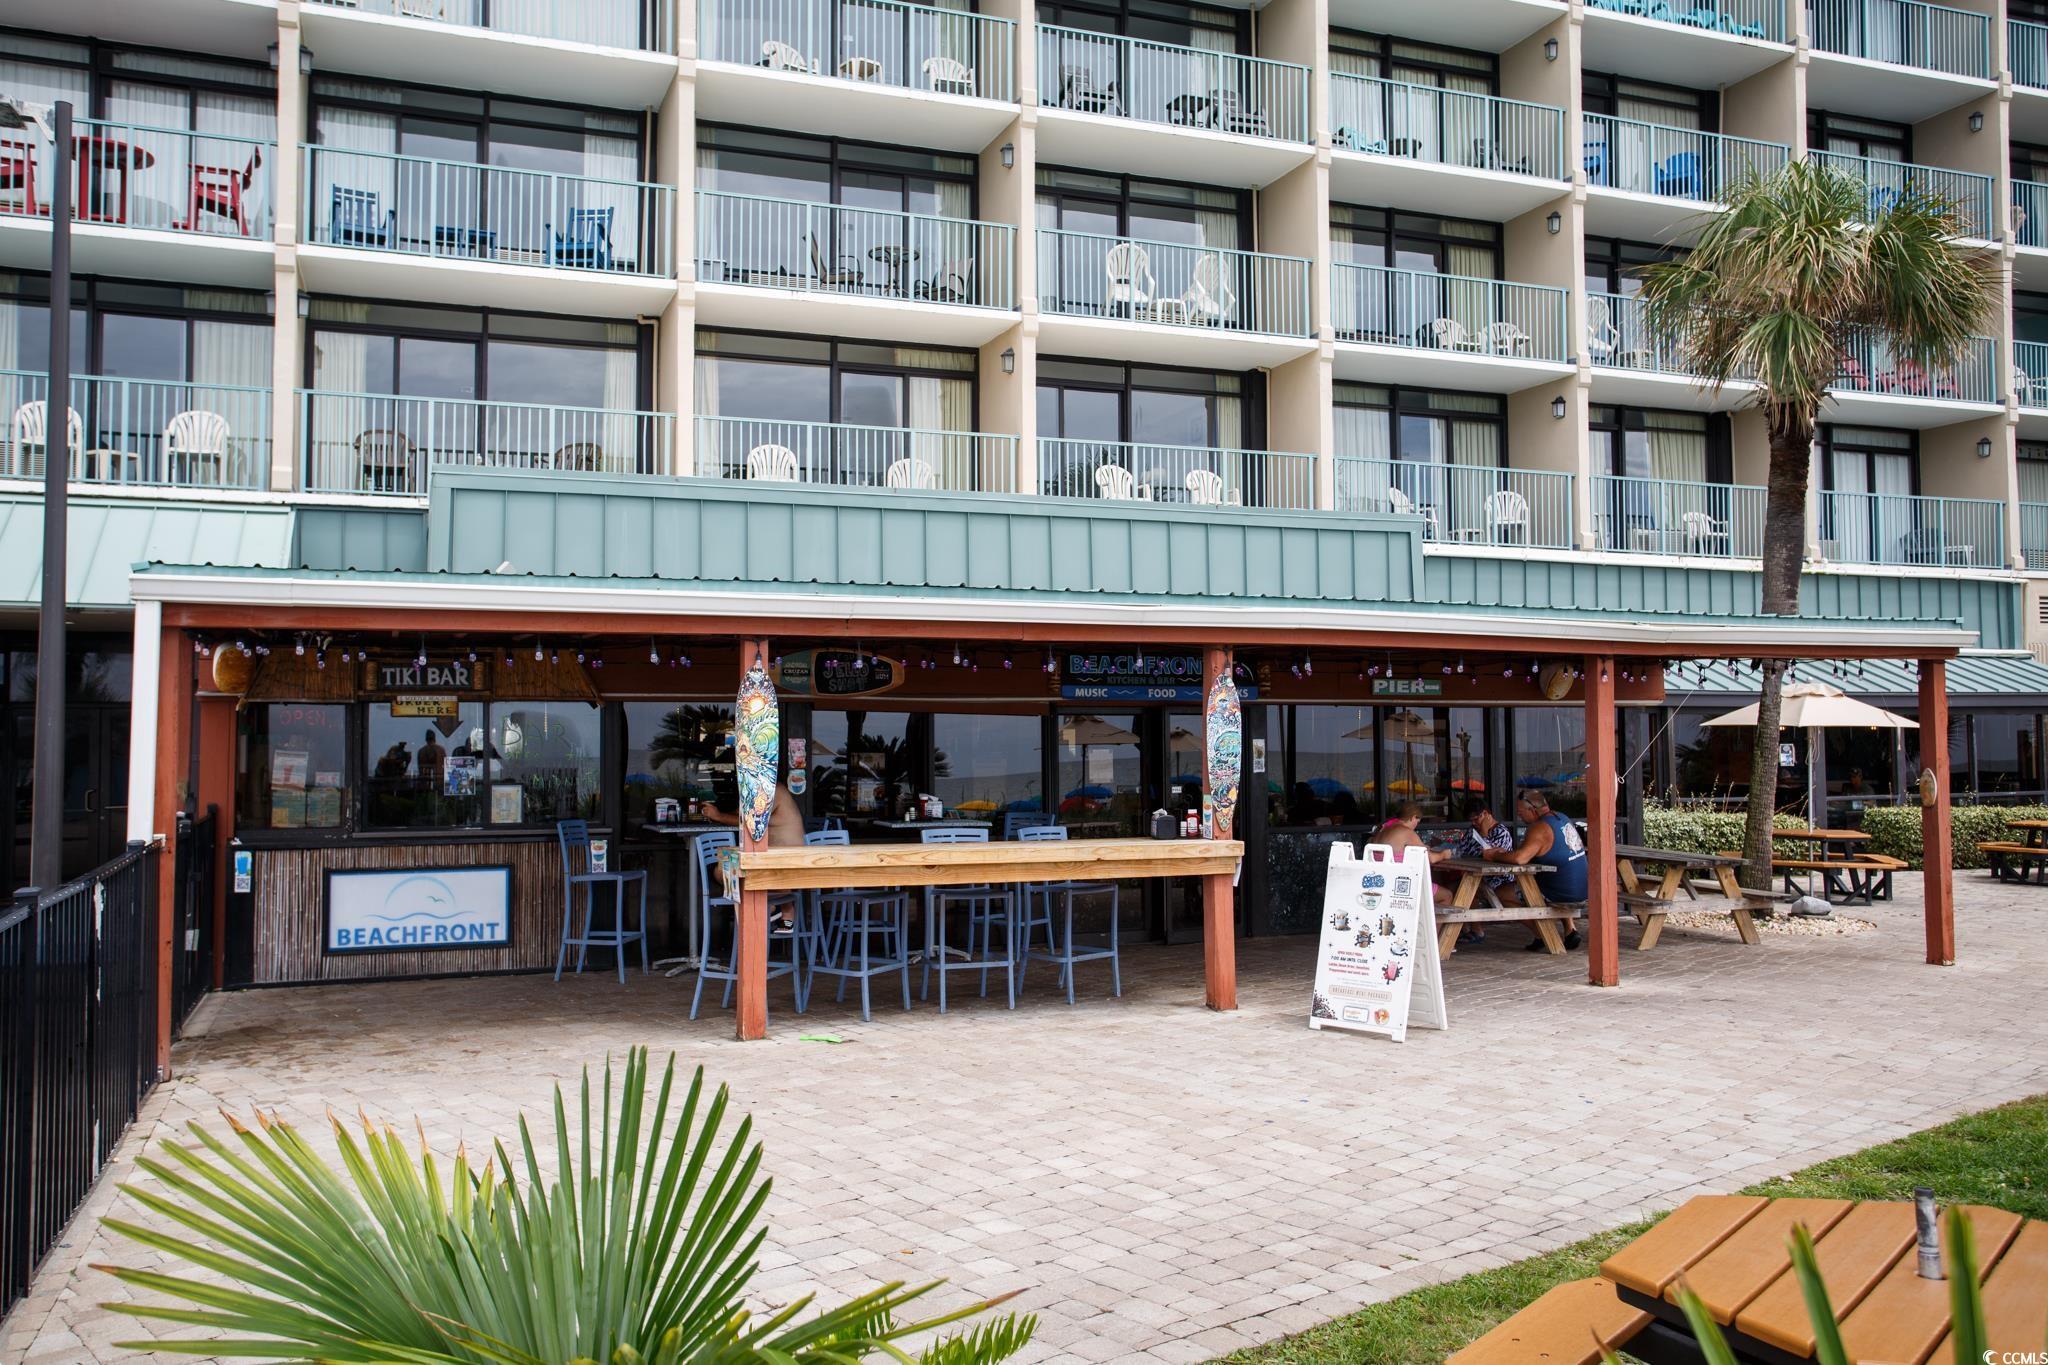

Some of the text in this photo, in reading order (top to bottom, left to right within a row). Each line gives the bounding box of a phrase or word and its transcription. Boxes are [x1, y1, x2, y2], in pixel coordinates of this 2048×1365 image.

[1070, 655, 1203, 675] BEACHFRON
[382, 667, 470, 686] TIKI BAR
[1106, 676, 1147, 685] KITCHEN
[1159, 677, 1176, 685] BAR
[1075, 688, 1177, 698] MUSIC FOOD
[417, 706, 454, 714] HERE
[337, 922, 500, 946] BEACHFRONT
